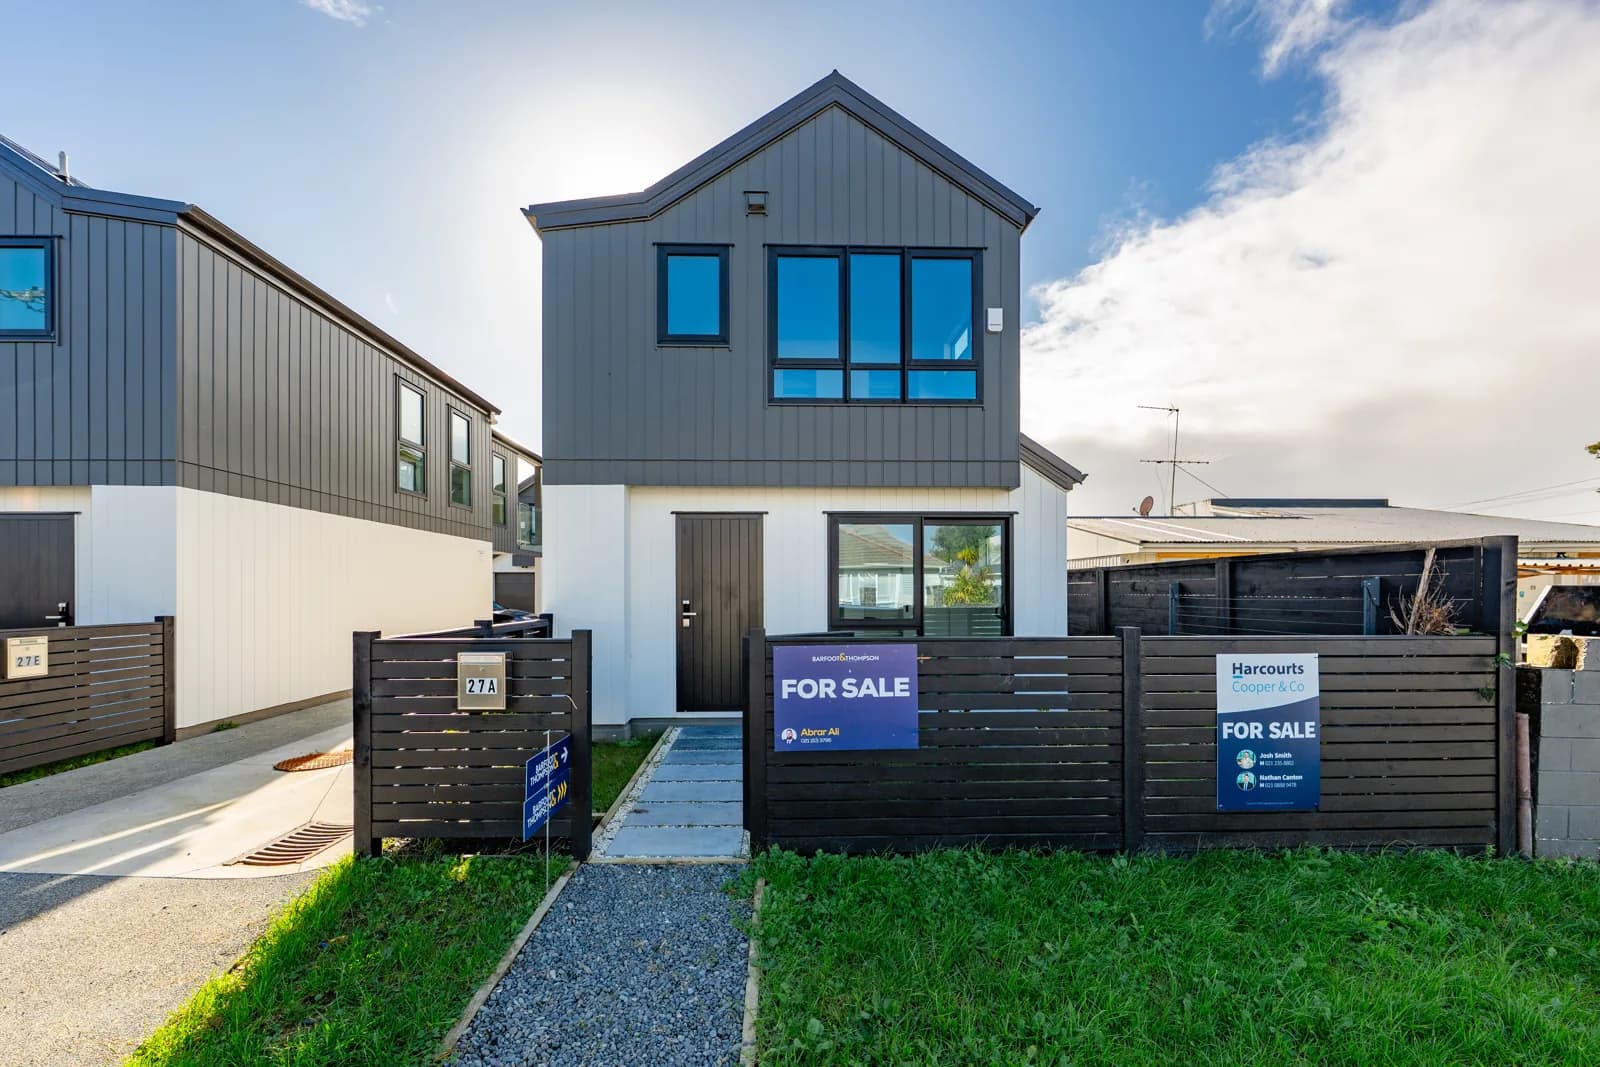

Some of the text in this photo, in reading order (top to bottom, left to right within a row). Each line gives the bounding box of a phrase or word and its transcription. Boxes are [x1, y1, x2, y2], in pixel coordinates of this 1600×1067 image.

[17, 655, 40, 667] 27E
[1232, 662, 1304, 675] Harcourts
[468, 679, 496, 693] 27A
[781, 677, 910, 699] FOR SALE
[1232, 681, 1304, 695] Cooper & Co
[800, 727, 840, 737] Abrar Ali
[1222, 721, 1316, 740] FOR SALE
